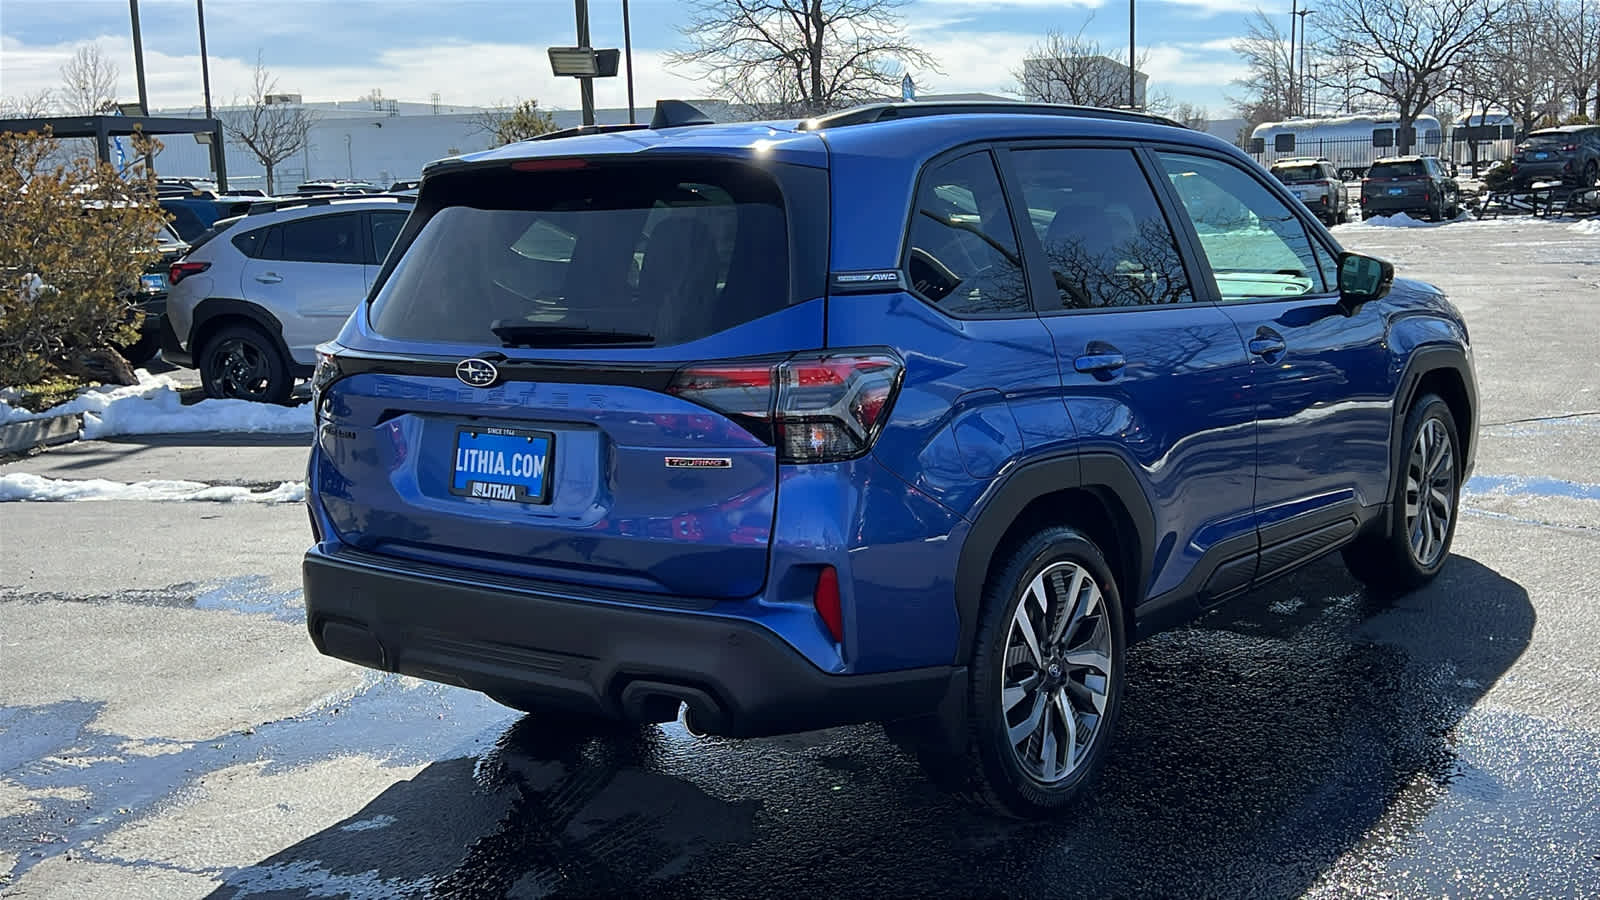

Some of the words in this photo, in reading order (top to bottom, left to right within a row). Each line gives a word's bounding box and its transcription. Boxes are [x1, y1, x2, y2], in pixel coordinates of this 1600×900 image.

[871, 273, 897, 281] AWD
[455, 448, 546, 479] LITHIA.COM
[671, 459, 725, 467] TOURING
[481, 483, 516, 500] LITHIA
